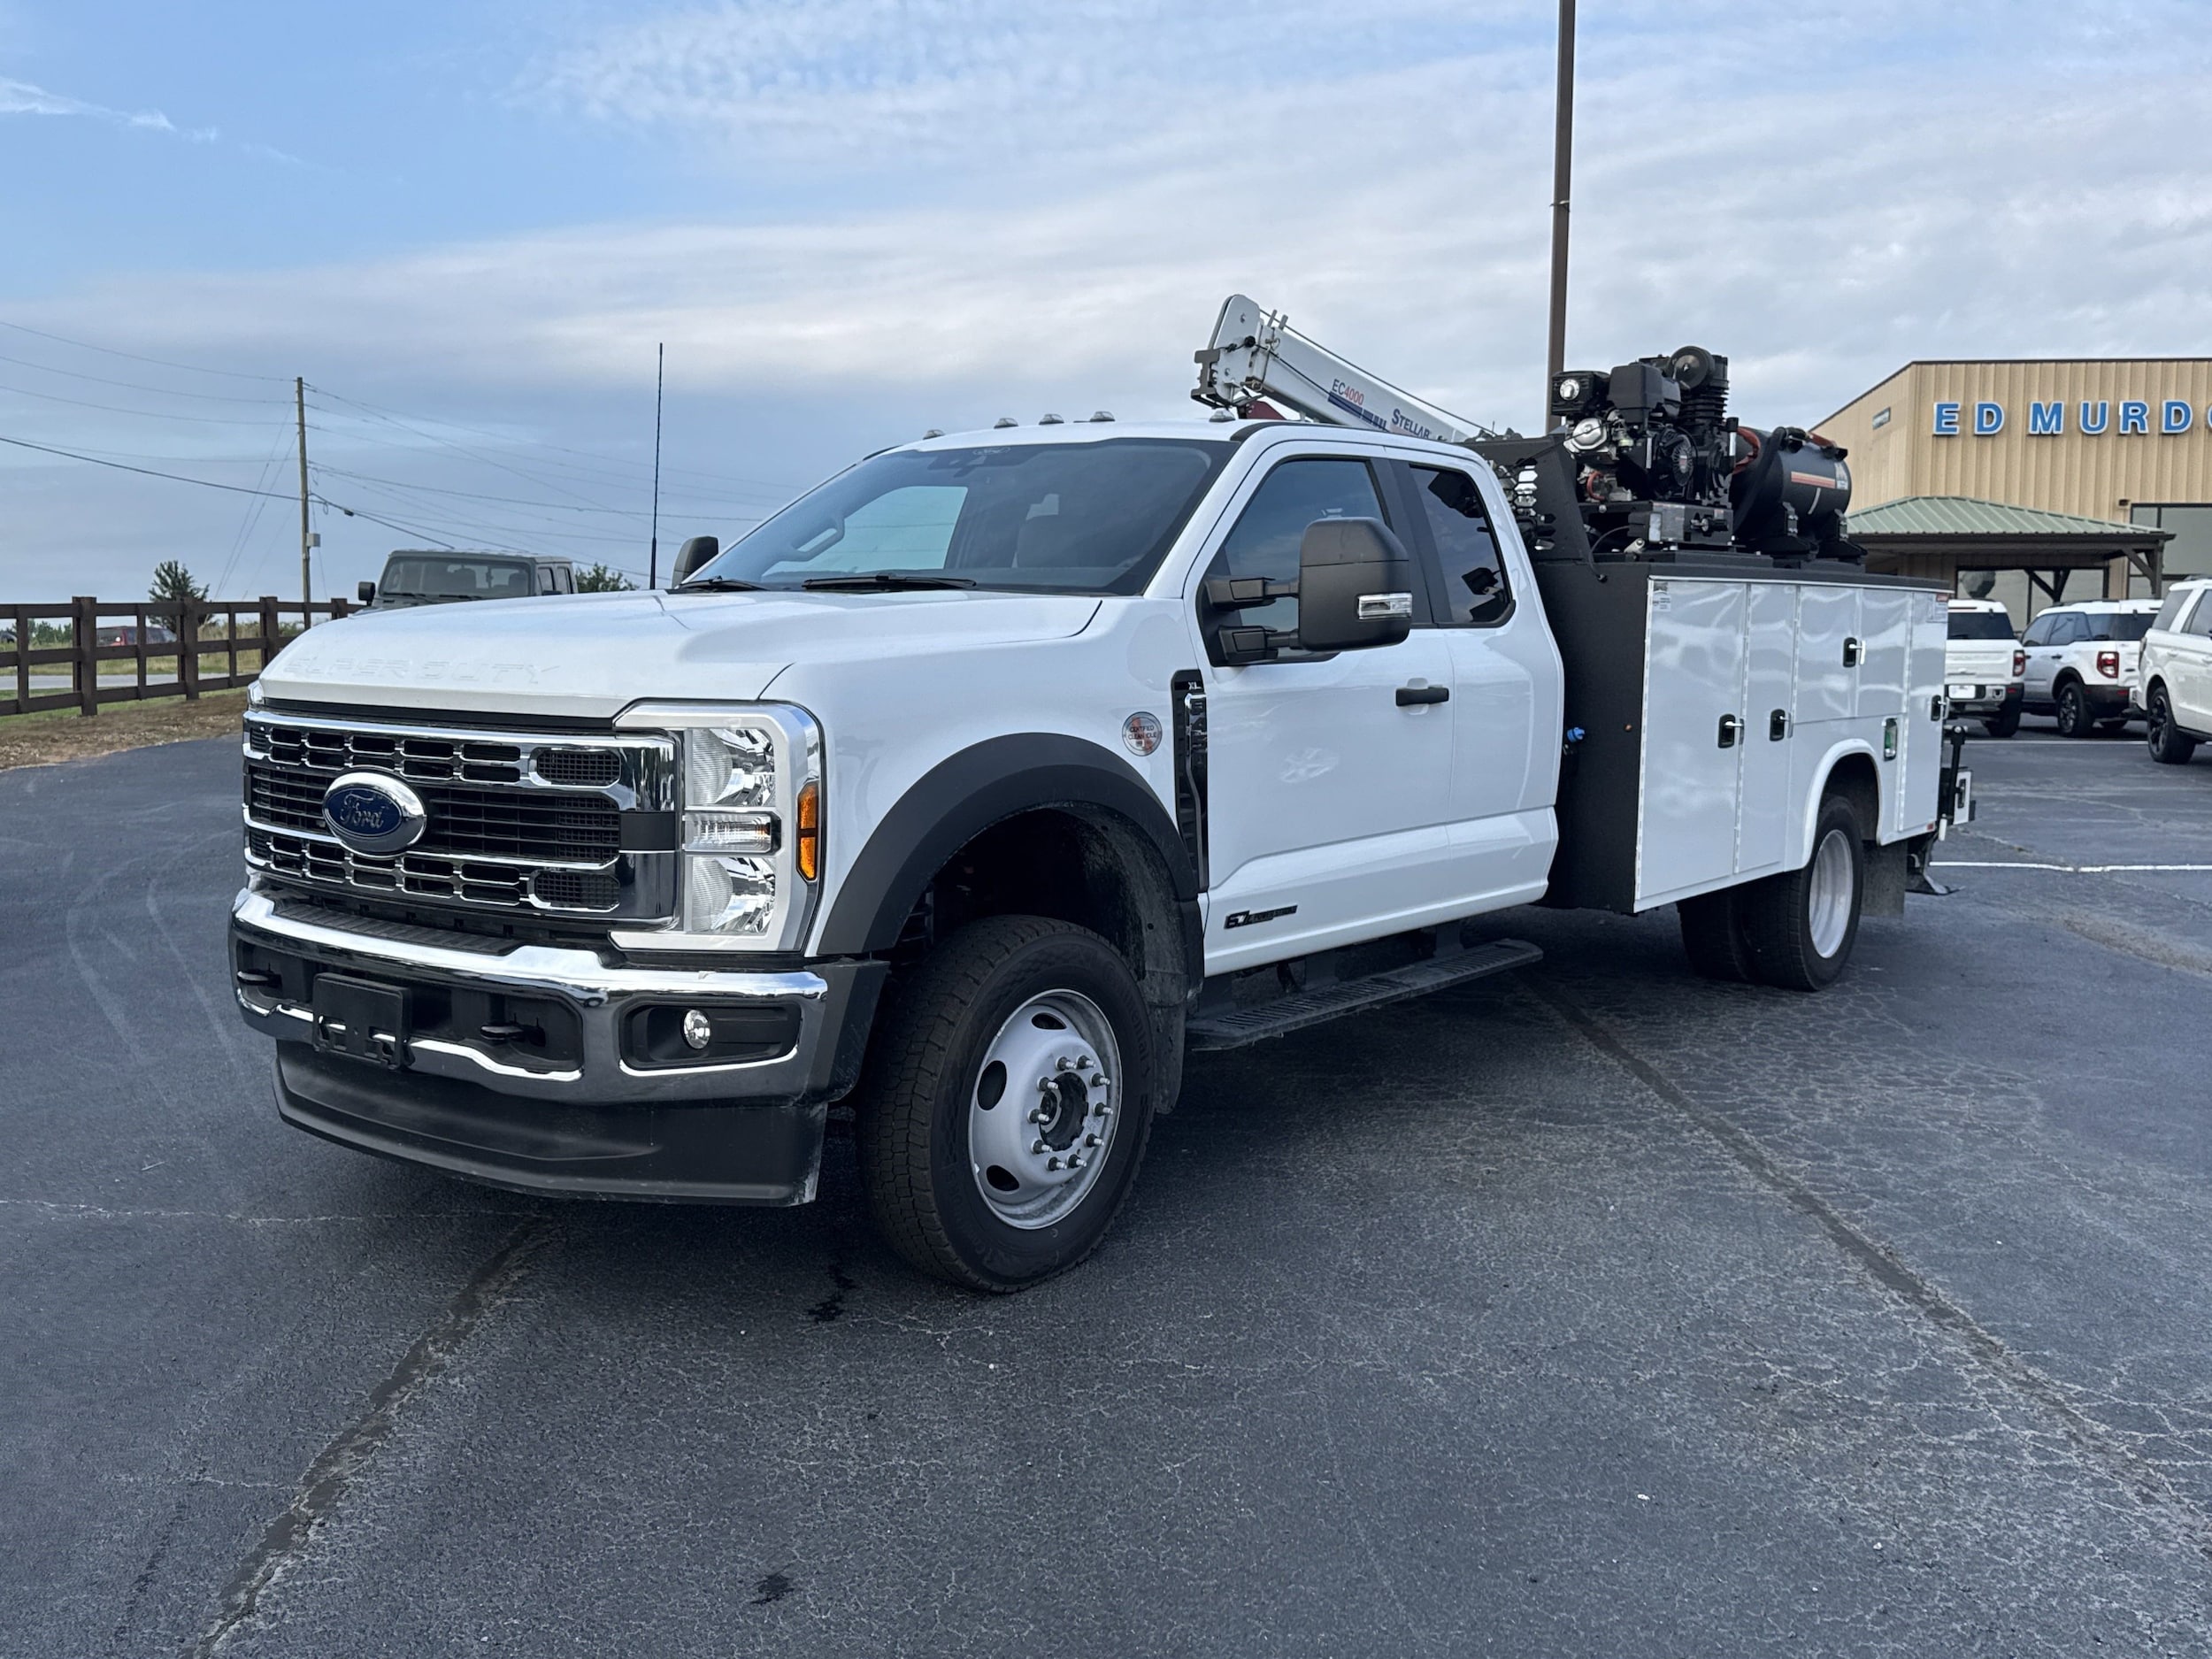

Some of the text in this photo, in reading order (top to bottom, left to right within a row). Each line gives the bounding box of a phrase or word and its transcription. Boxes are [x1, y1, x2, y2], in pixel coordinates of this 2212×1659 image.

[1332, 379, 1365, 405] EC4000
[1391, 408, 1432, 440] STELLAR
[1933, 400, 2212, 434] ED MURD
[1187, 681, 1202, 690] XL
[340, 791, 385, 829] Ford
